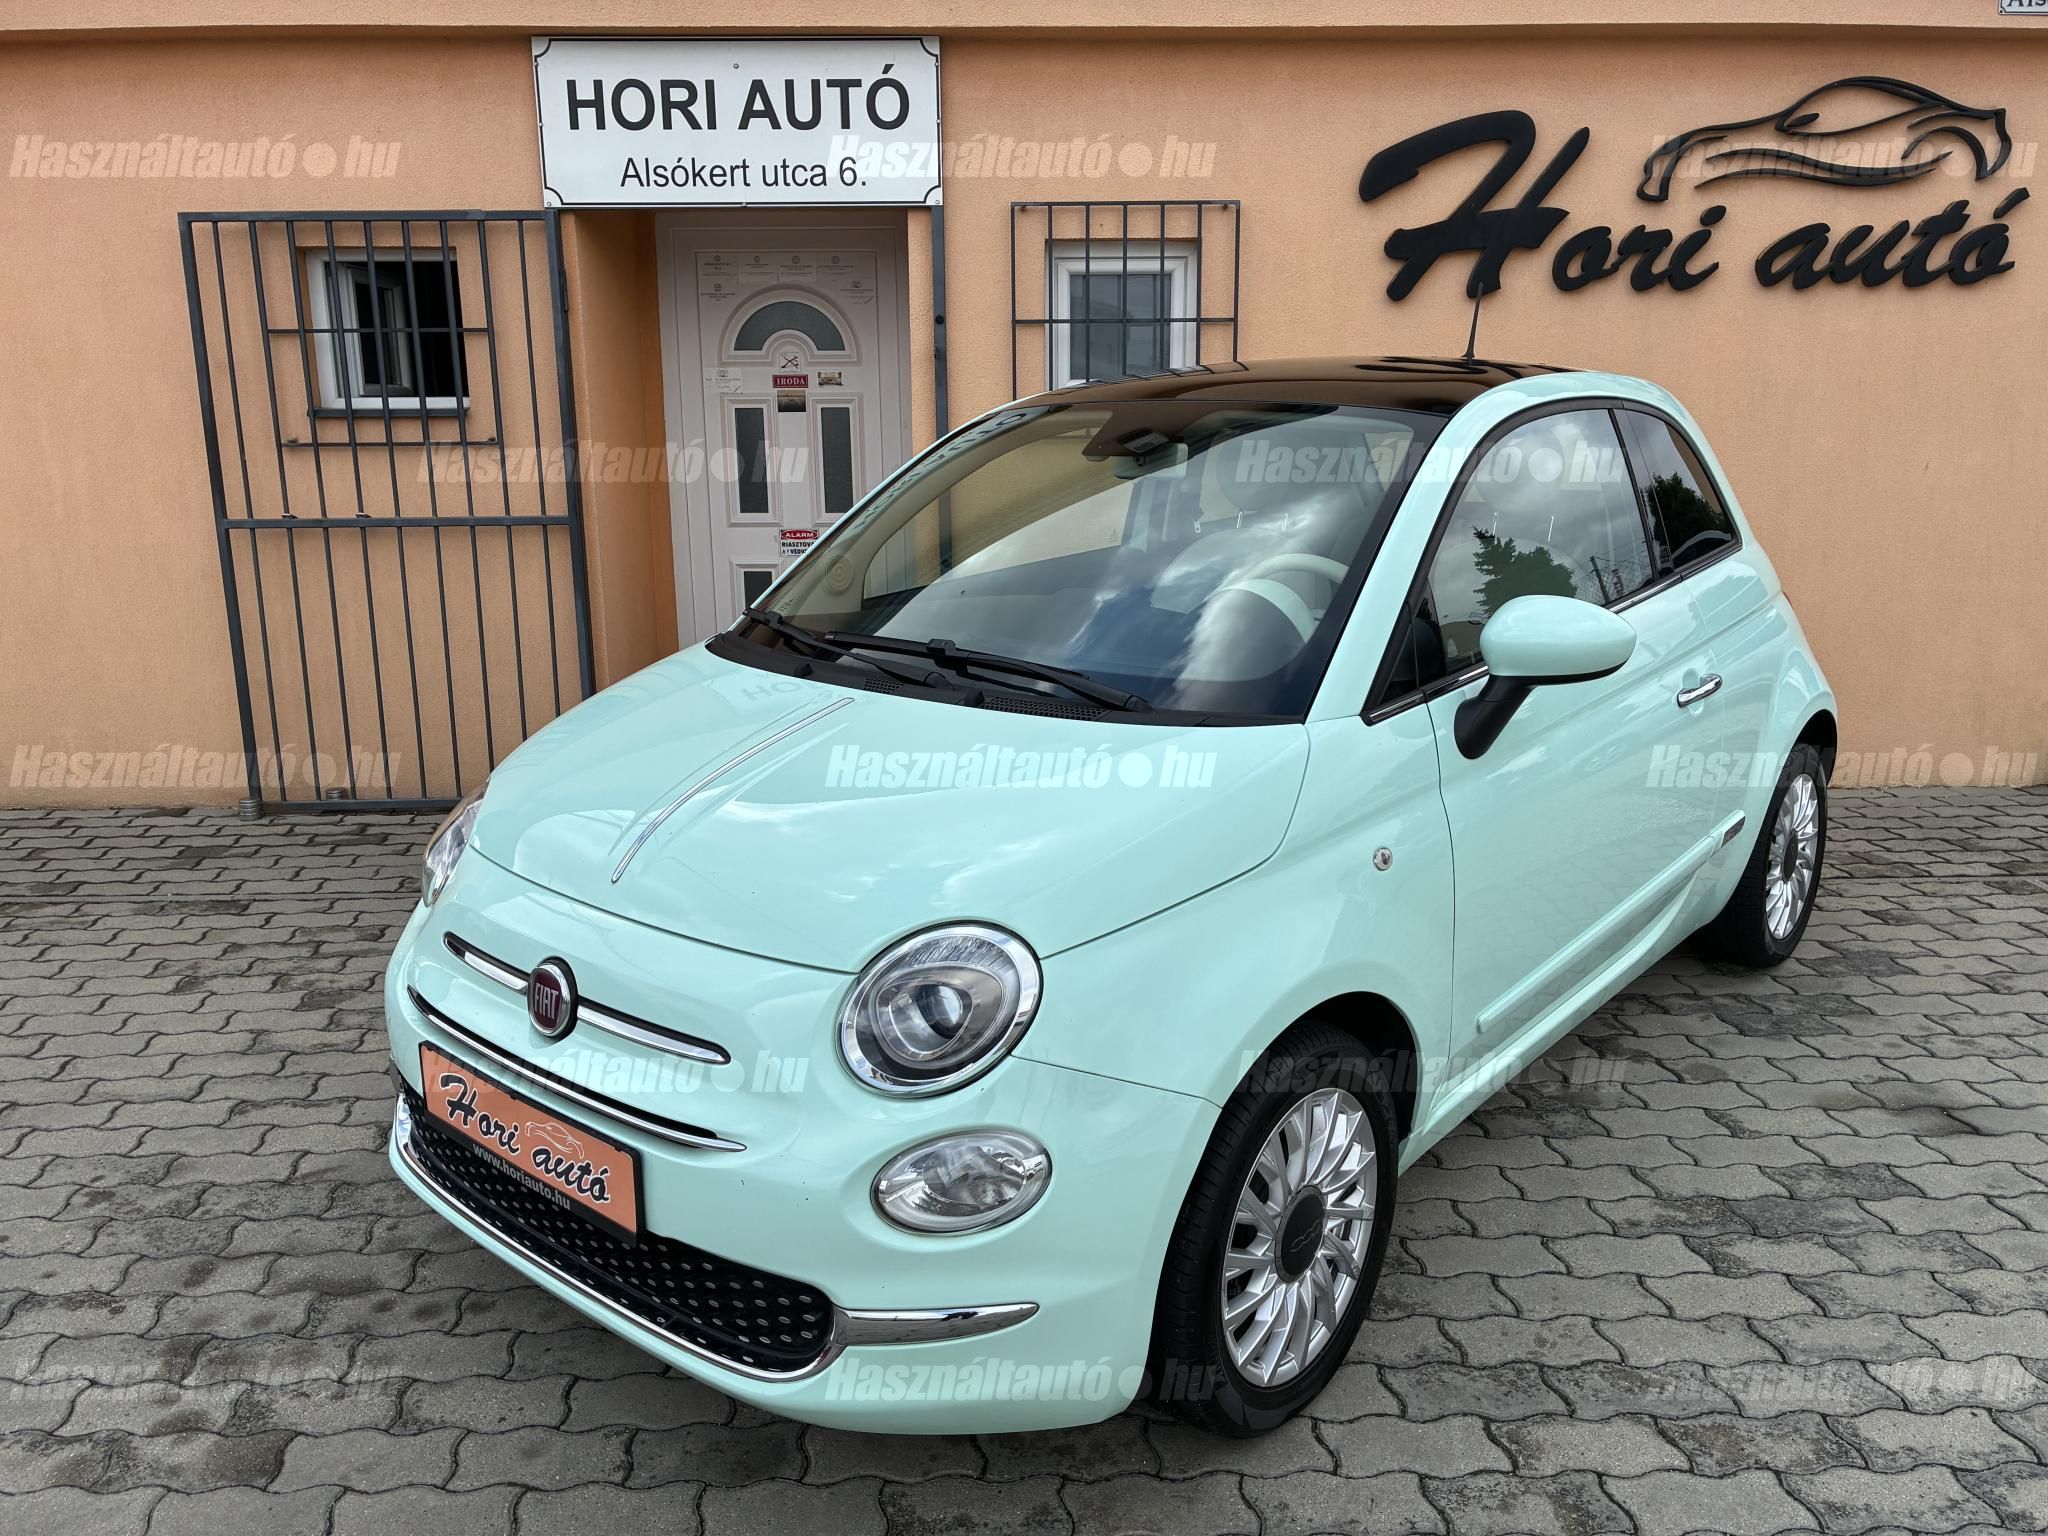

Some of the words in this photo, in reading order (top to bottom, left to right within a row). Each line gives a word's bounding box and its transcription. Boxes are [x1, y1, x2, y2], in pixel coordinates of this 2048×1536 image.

[566, 78, 717, 131] HORI
[738, 64, 910, 131] AUTÓ
[620, 156, 750, 188] Alsókert
[762, 158, 828, 188] utca
[839, 157, 867, 188] 6.
[1358, 109, 1729, 302] Hori
[1755, 187, 2031, 290] autó
[776, 377, 806, 386] IRODA
[534, 982, 559, 1020] FIAT
[439, 1073, 520, 1155] Hori
[531, 1146, 611, 1204] autó
[472, 1143, 571, 1210] www.horiauto.hu
